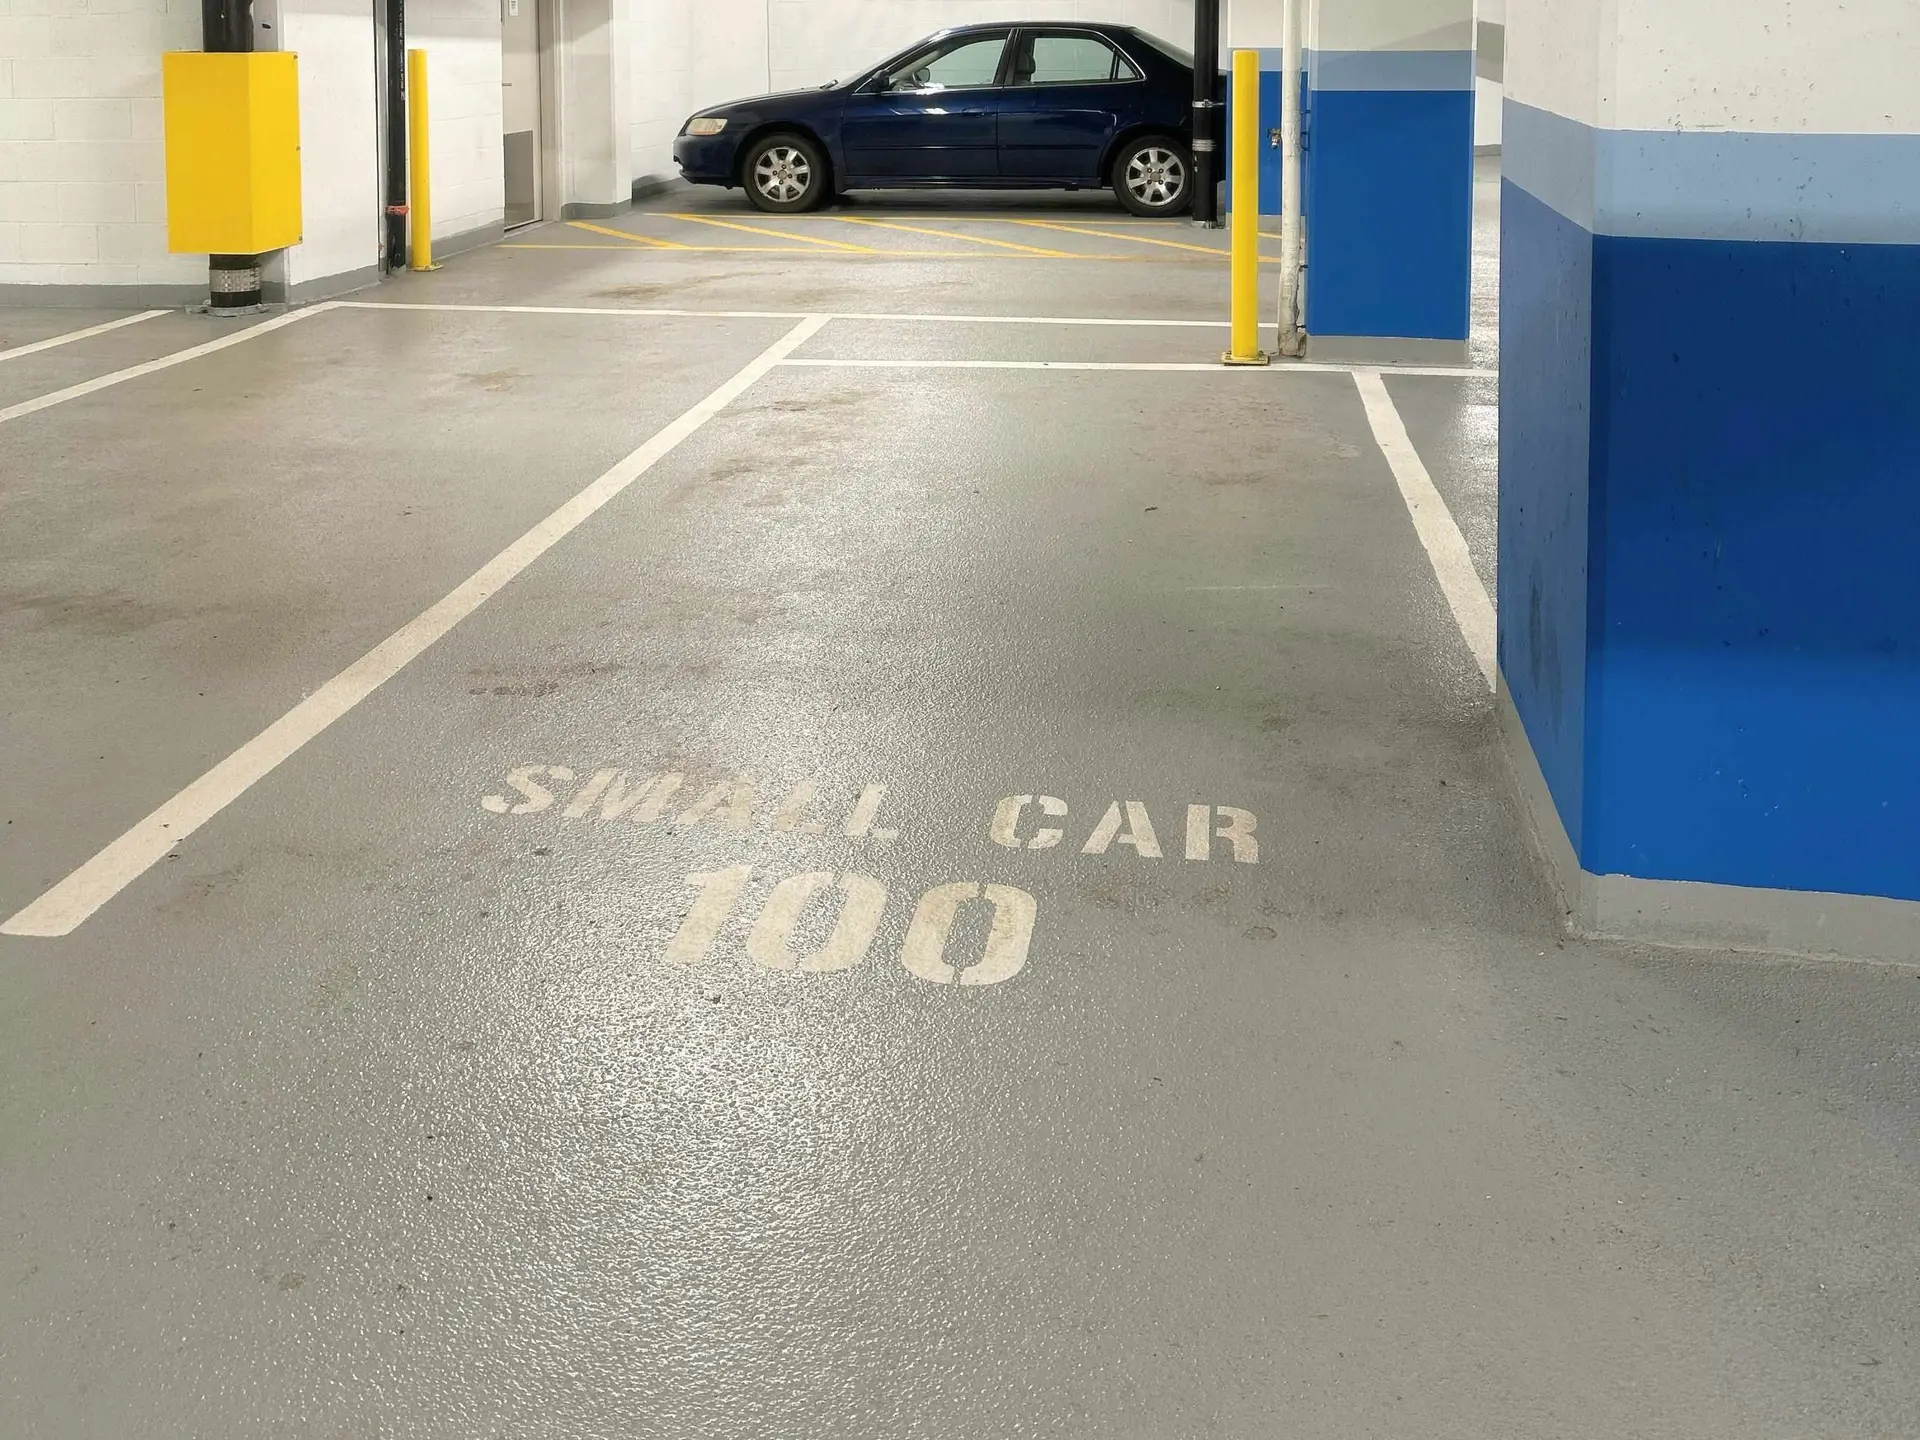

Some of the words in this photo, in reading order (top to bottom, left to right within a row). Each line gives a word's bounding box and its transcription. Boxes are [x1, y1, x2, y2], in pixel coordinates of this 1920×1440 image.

[482, 765, 899, 840] SMALL
[989, 794, 1259, 864] CAR
[662, 864, 1037, 986] 100
